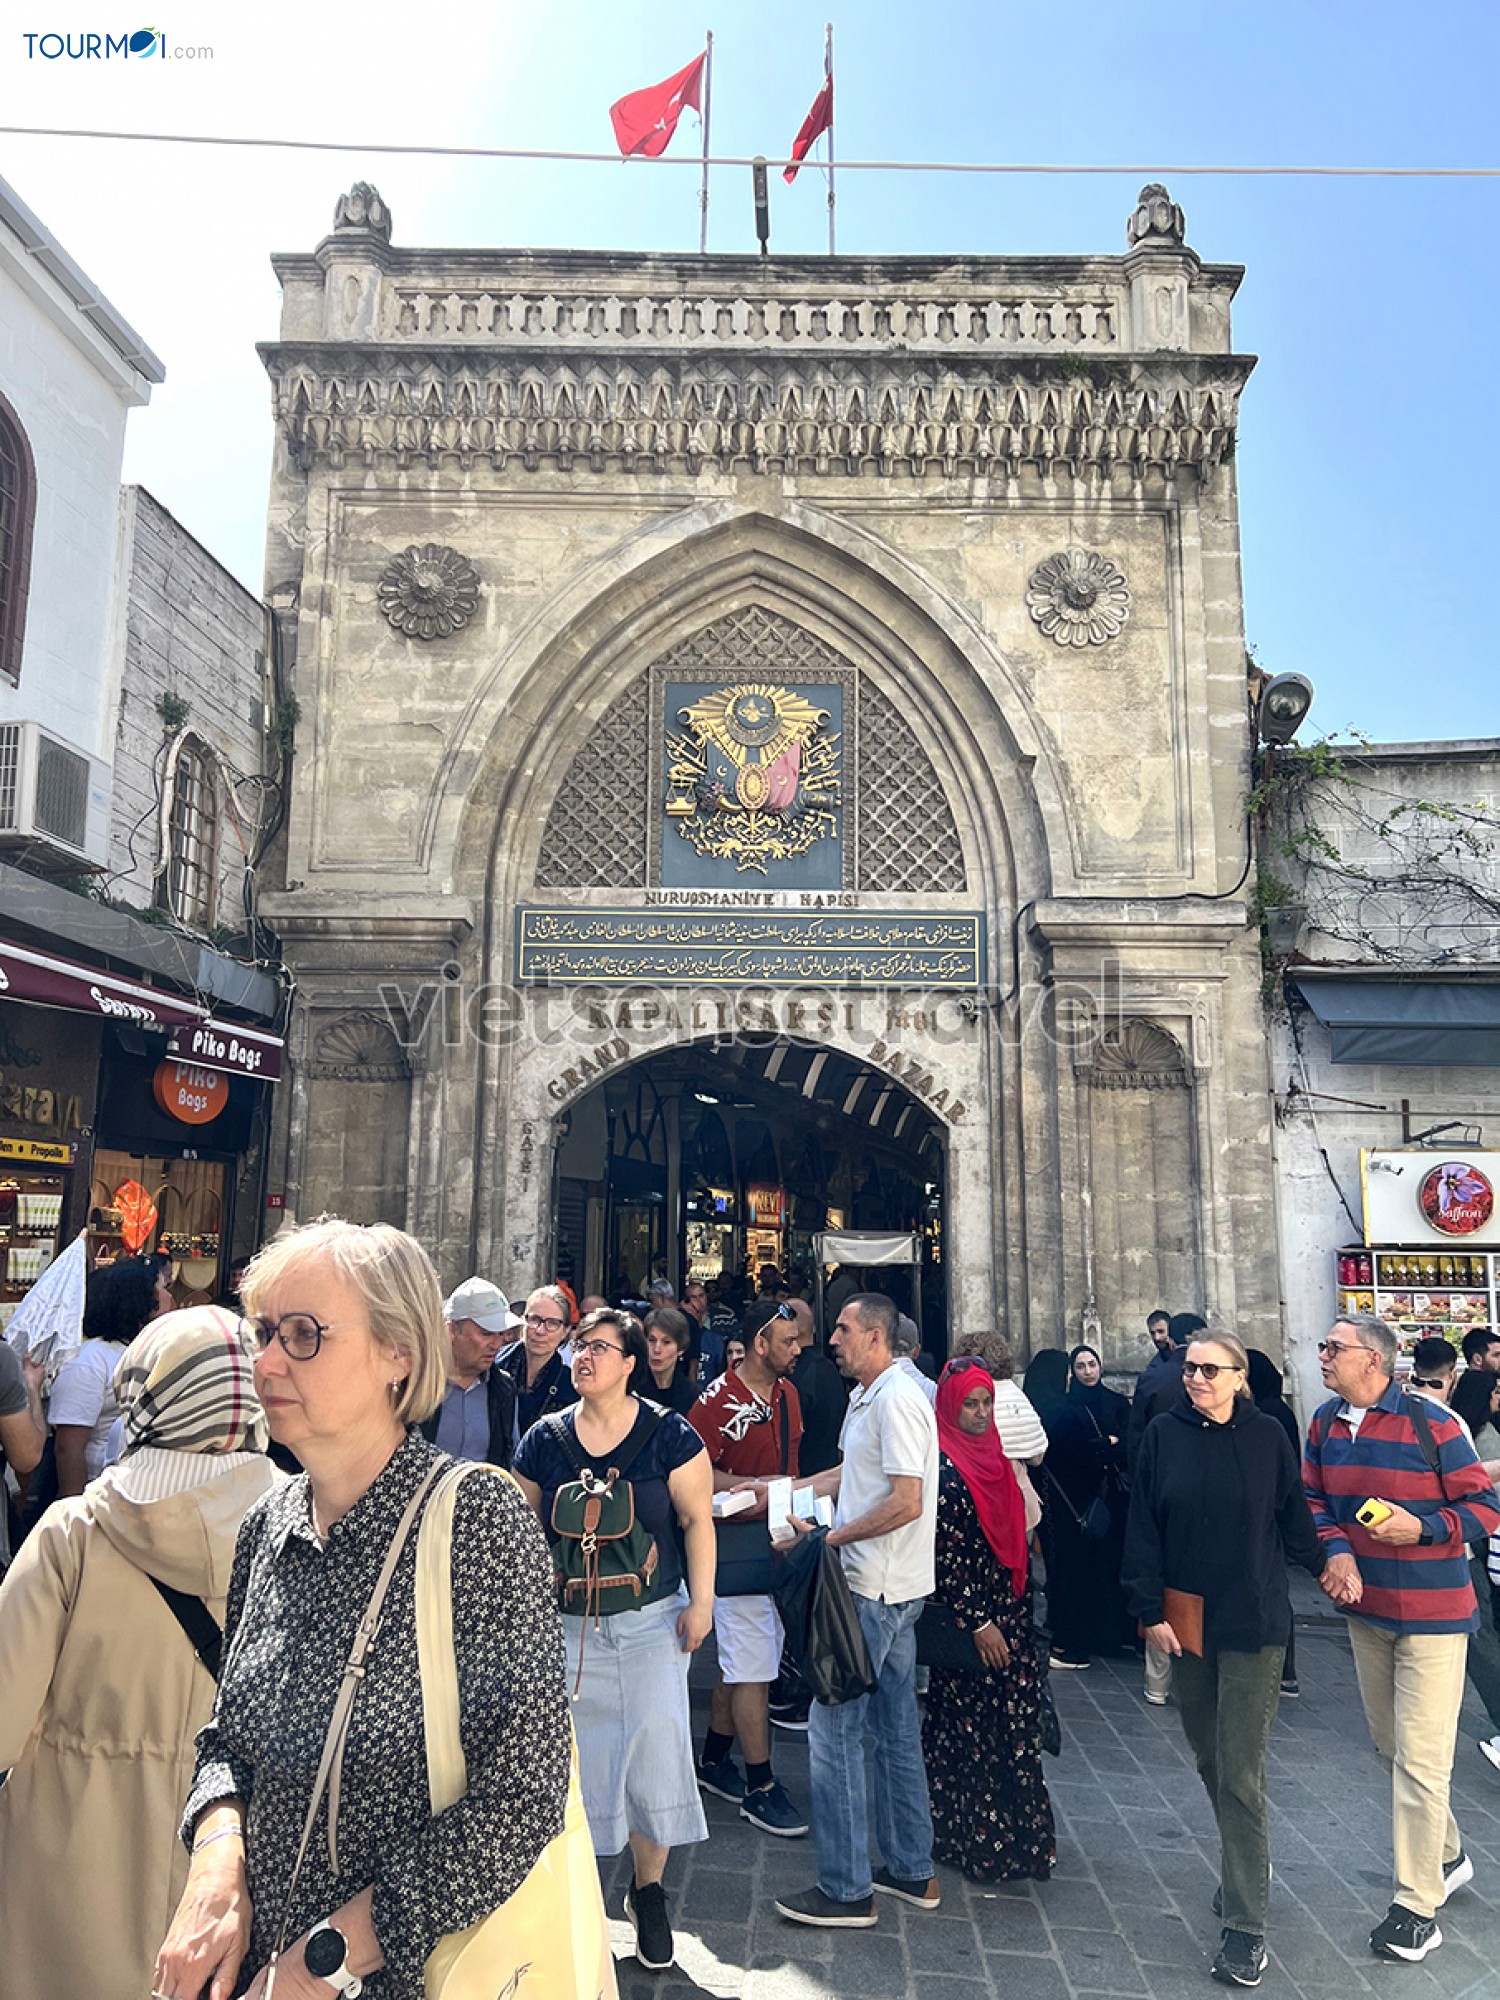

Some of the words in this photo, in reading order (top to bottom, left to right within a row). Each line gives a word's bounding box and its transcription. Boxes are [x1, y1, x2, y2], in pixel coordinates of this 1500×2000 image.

[192, 1030, 226, 1059] Piko
[227, 1039, 262, 1070] Bags
[547, 1037, 631, 1100] GRAND
[867, 1037, 967, 1125] BAZAAR
[178, 1088, 208, 1112] Bags
[31, 1143, 64, 1160] Propolis
